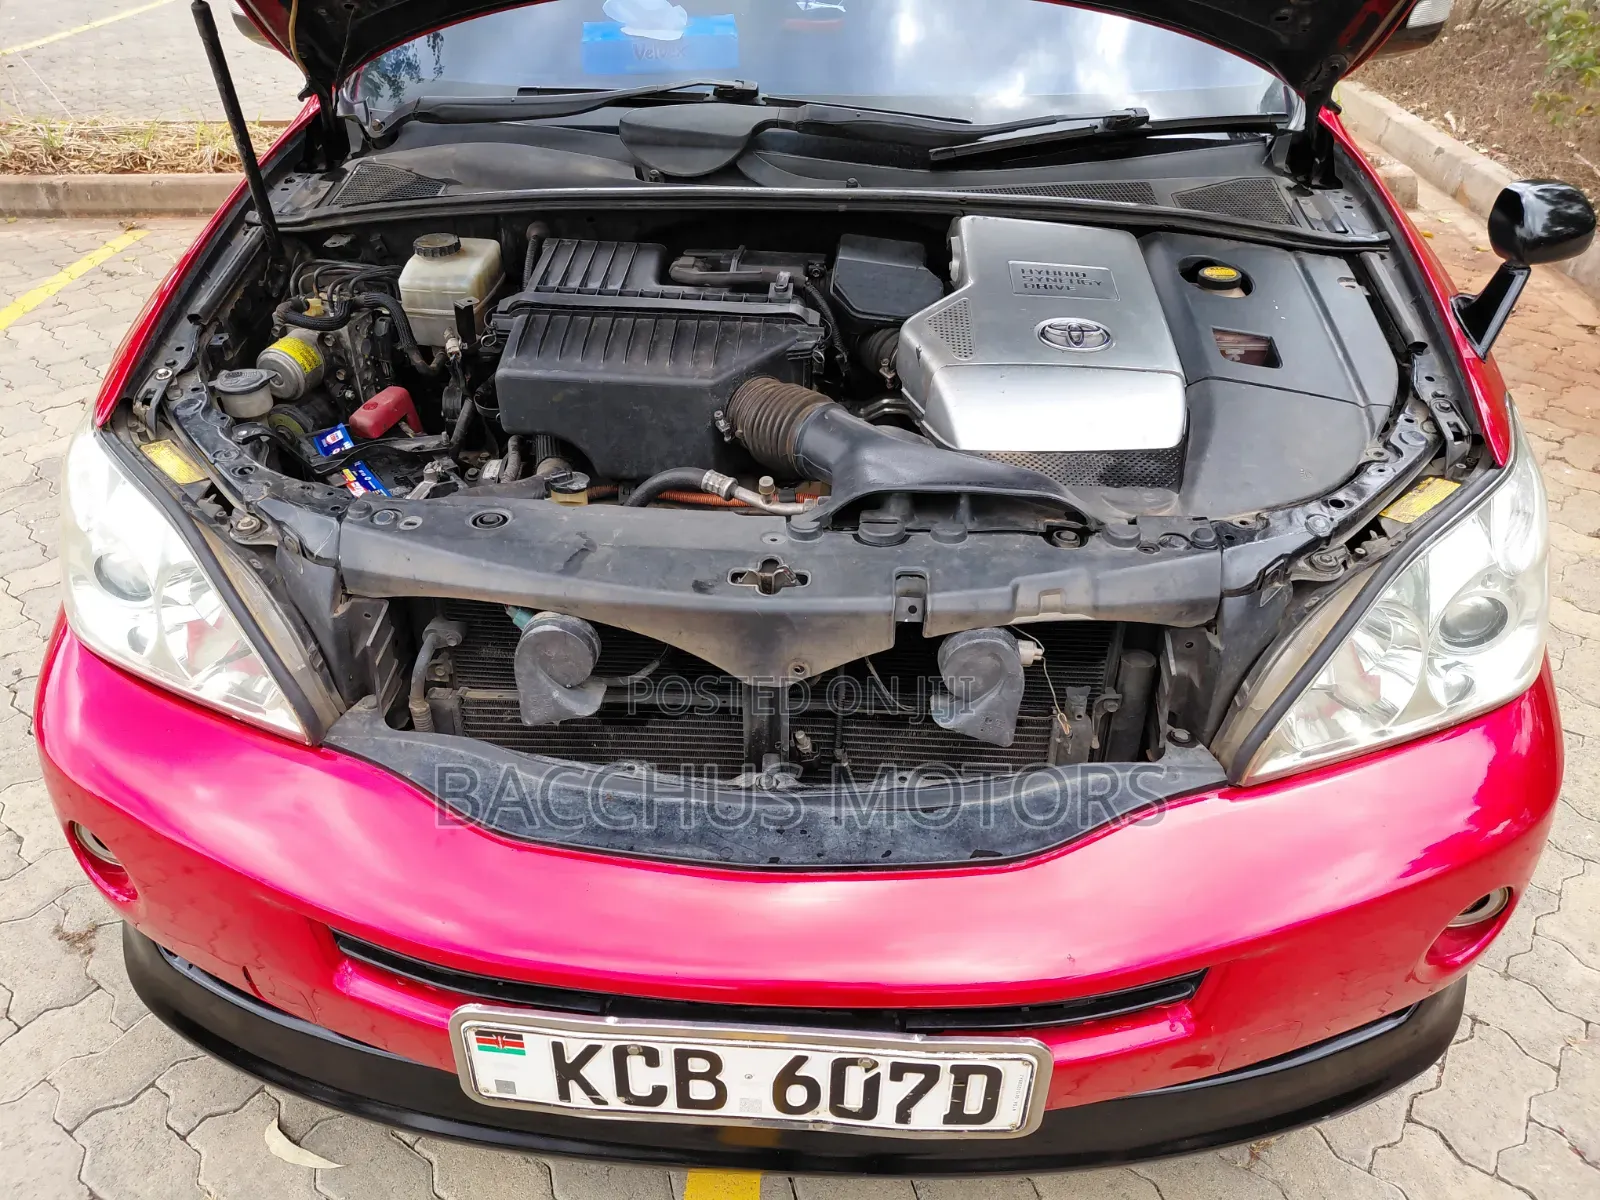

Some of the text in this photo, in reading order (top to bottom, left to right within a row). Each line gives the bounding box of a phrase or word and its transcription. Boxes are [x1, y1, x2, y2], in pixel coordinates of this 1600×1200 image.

[1024, 283, 1077, 291] DRIVE
[548, 1040, 728, 1111] KCB
[771, 1054, 1003, 1126] 607D
